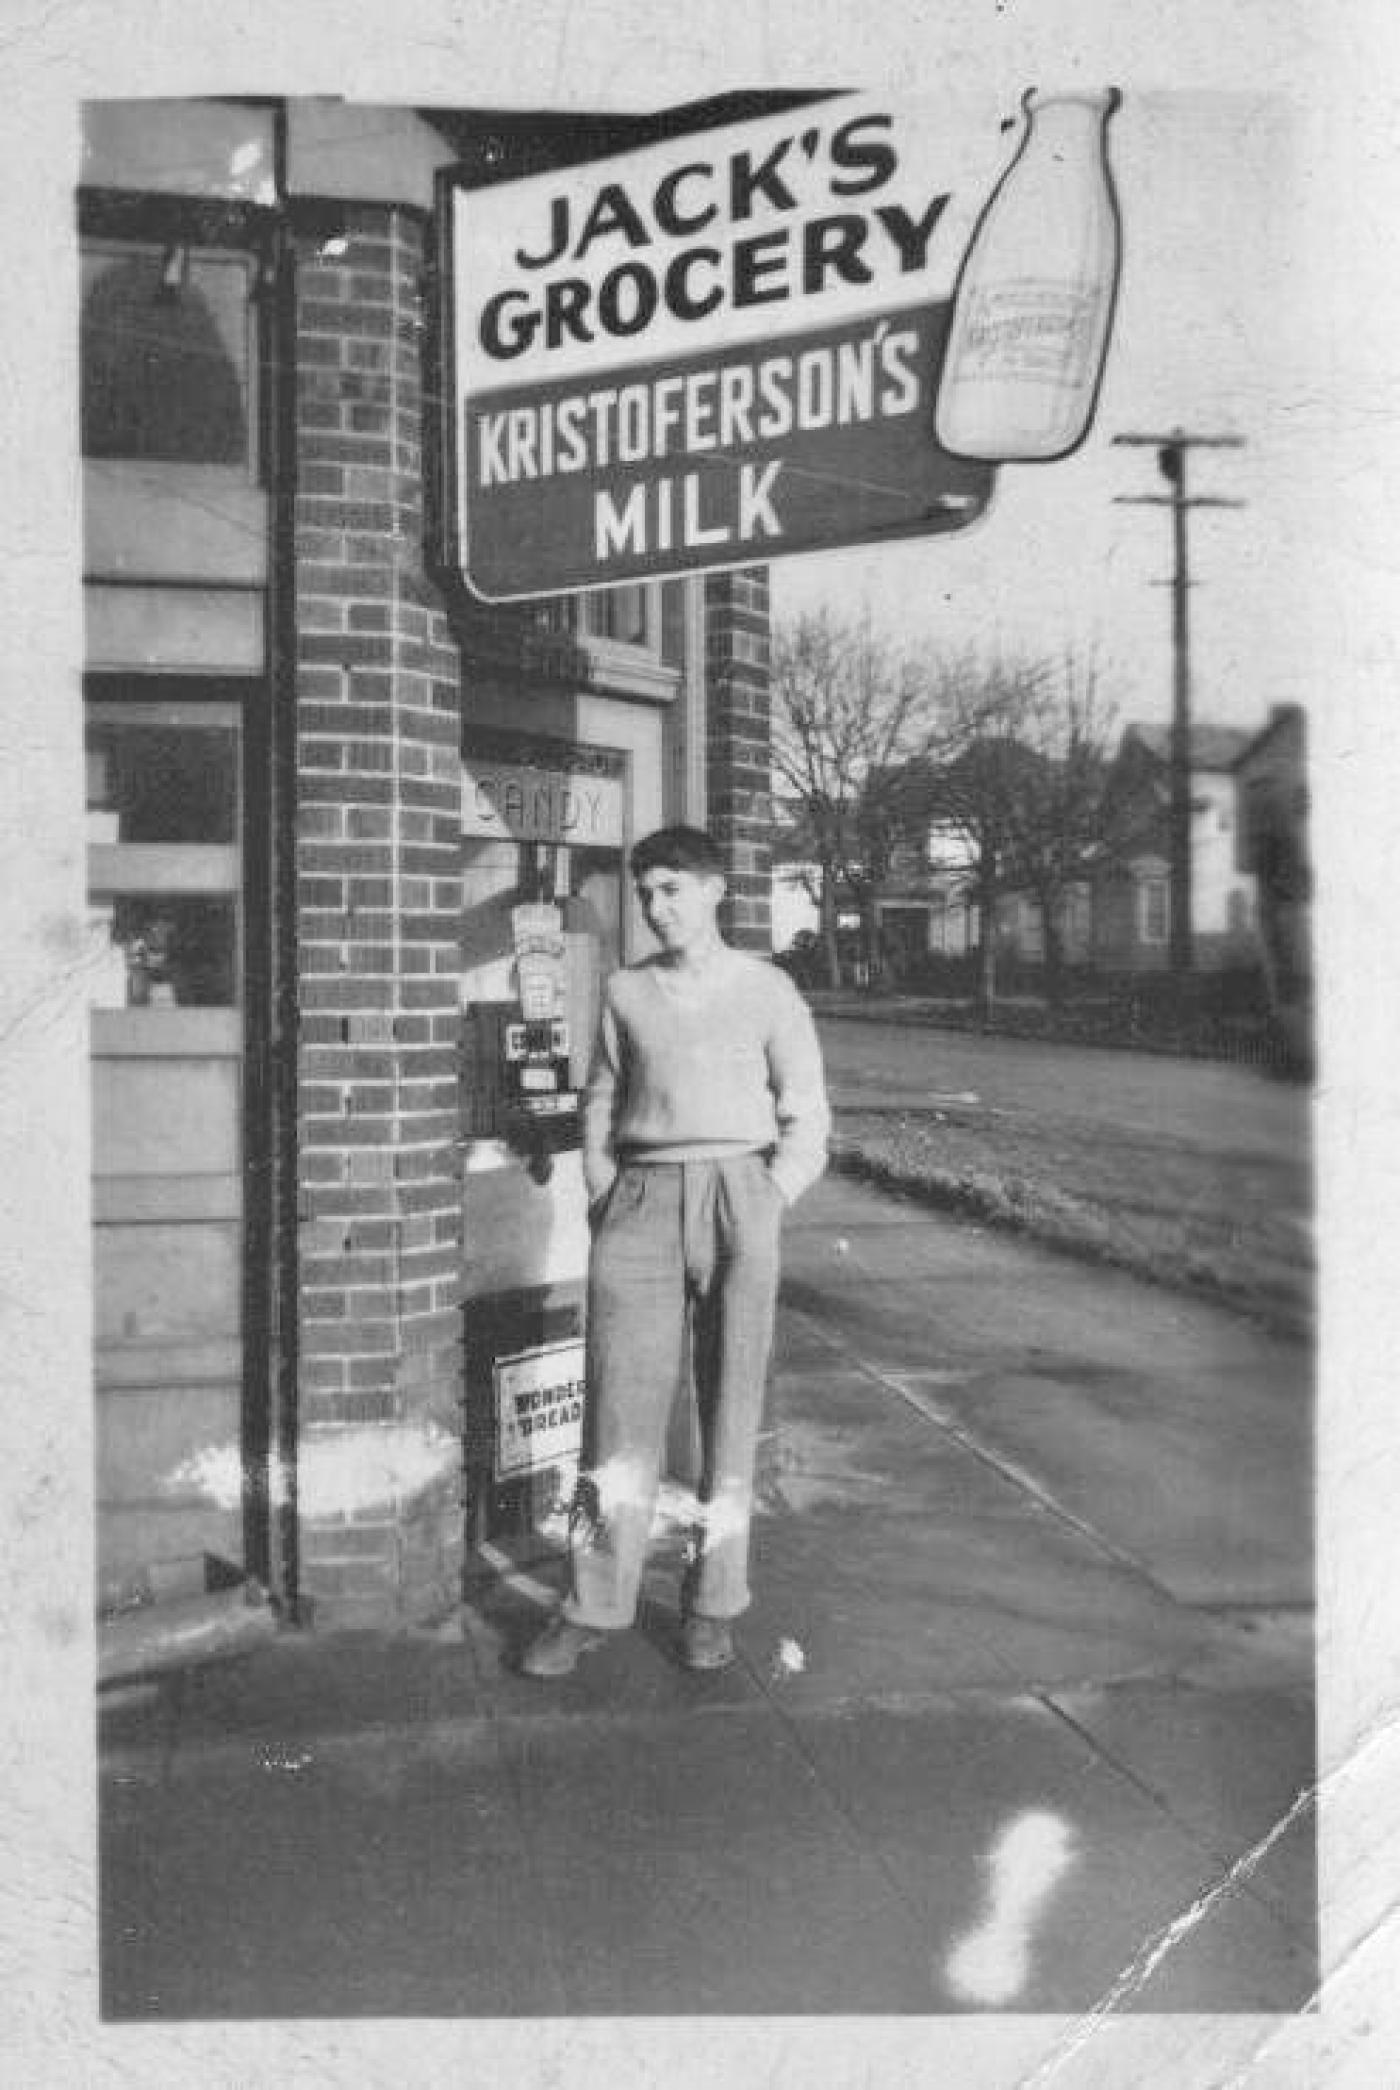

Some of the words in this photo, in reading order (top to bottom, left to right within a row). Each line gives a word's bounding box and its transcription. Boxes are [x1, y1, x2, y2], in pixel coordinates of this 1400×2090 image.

[515, 114, 898, 270] JACK'S
[478, 193, 951, 361] GROCERY
[477, 322, 921, 487] KRISTOFERSON'S
[594, 460, 782, 561] MILK
